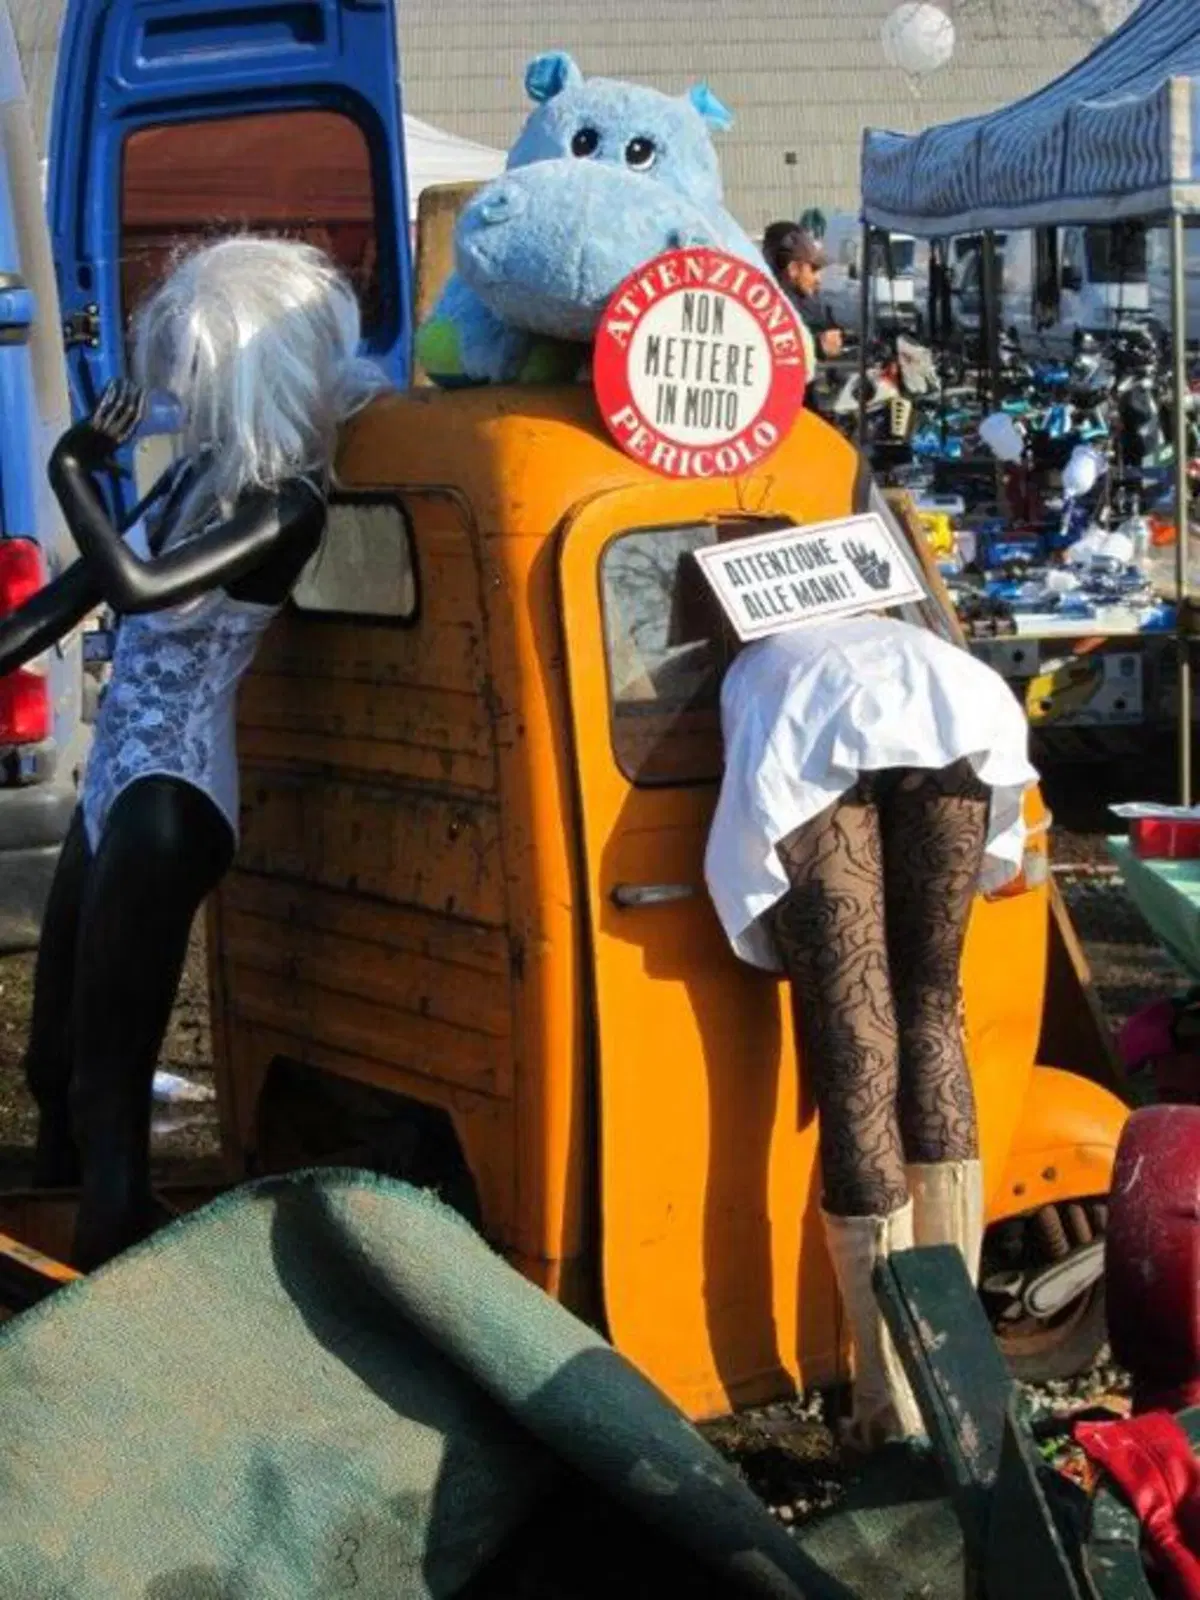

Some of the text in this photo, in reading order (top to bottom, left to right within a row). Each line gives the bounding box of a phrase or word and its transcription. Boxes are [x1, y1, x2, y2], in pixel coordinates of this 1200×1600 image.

[606, 255, 801, 366] ATTENZIONE!
[681, 292, 726, 335] NON
[643, 335, 756, 387] METTERE
[655, 384, 739, 431] IN MOTO
[609, 406, 778, 477] PERICOLO
[722, 536, 839, 588] ATTENZIONE
[740, 570, 857, 621] ALLE MANI!
